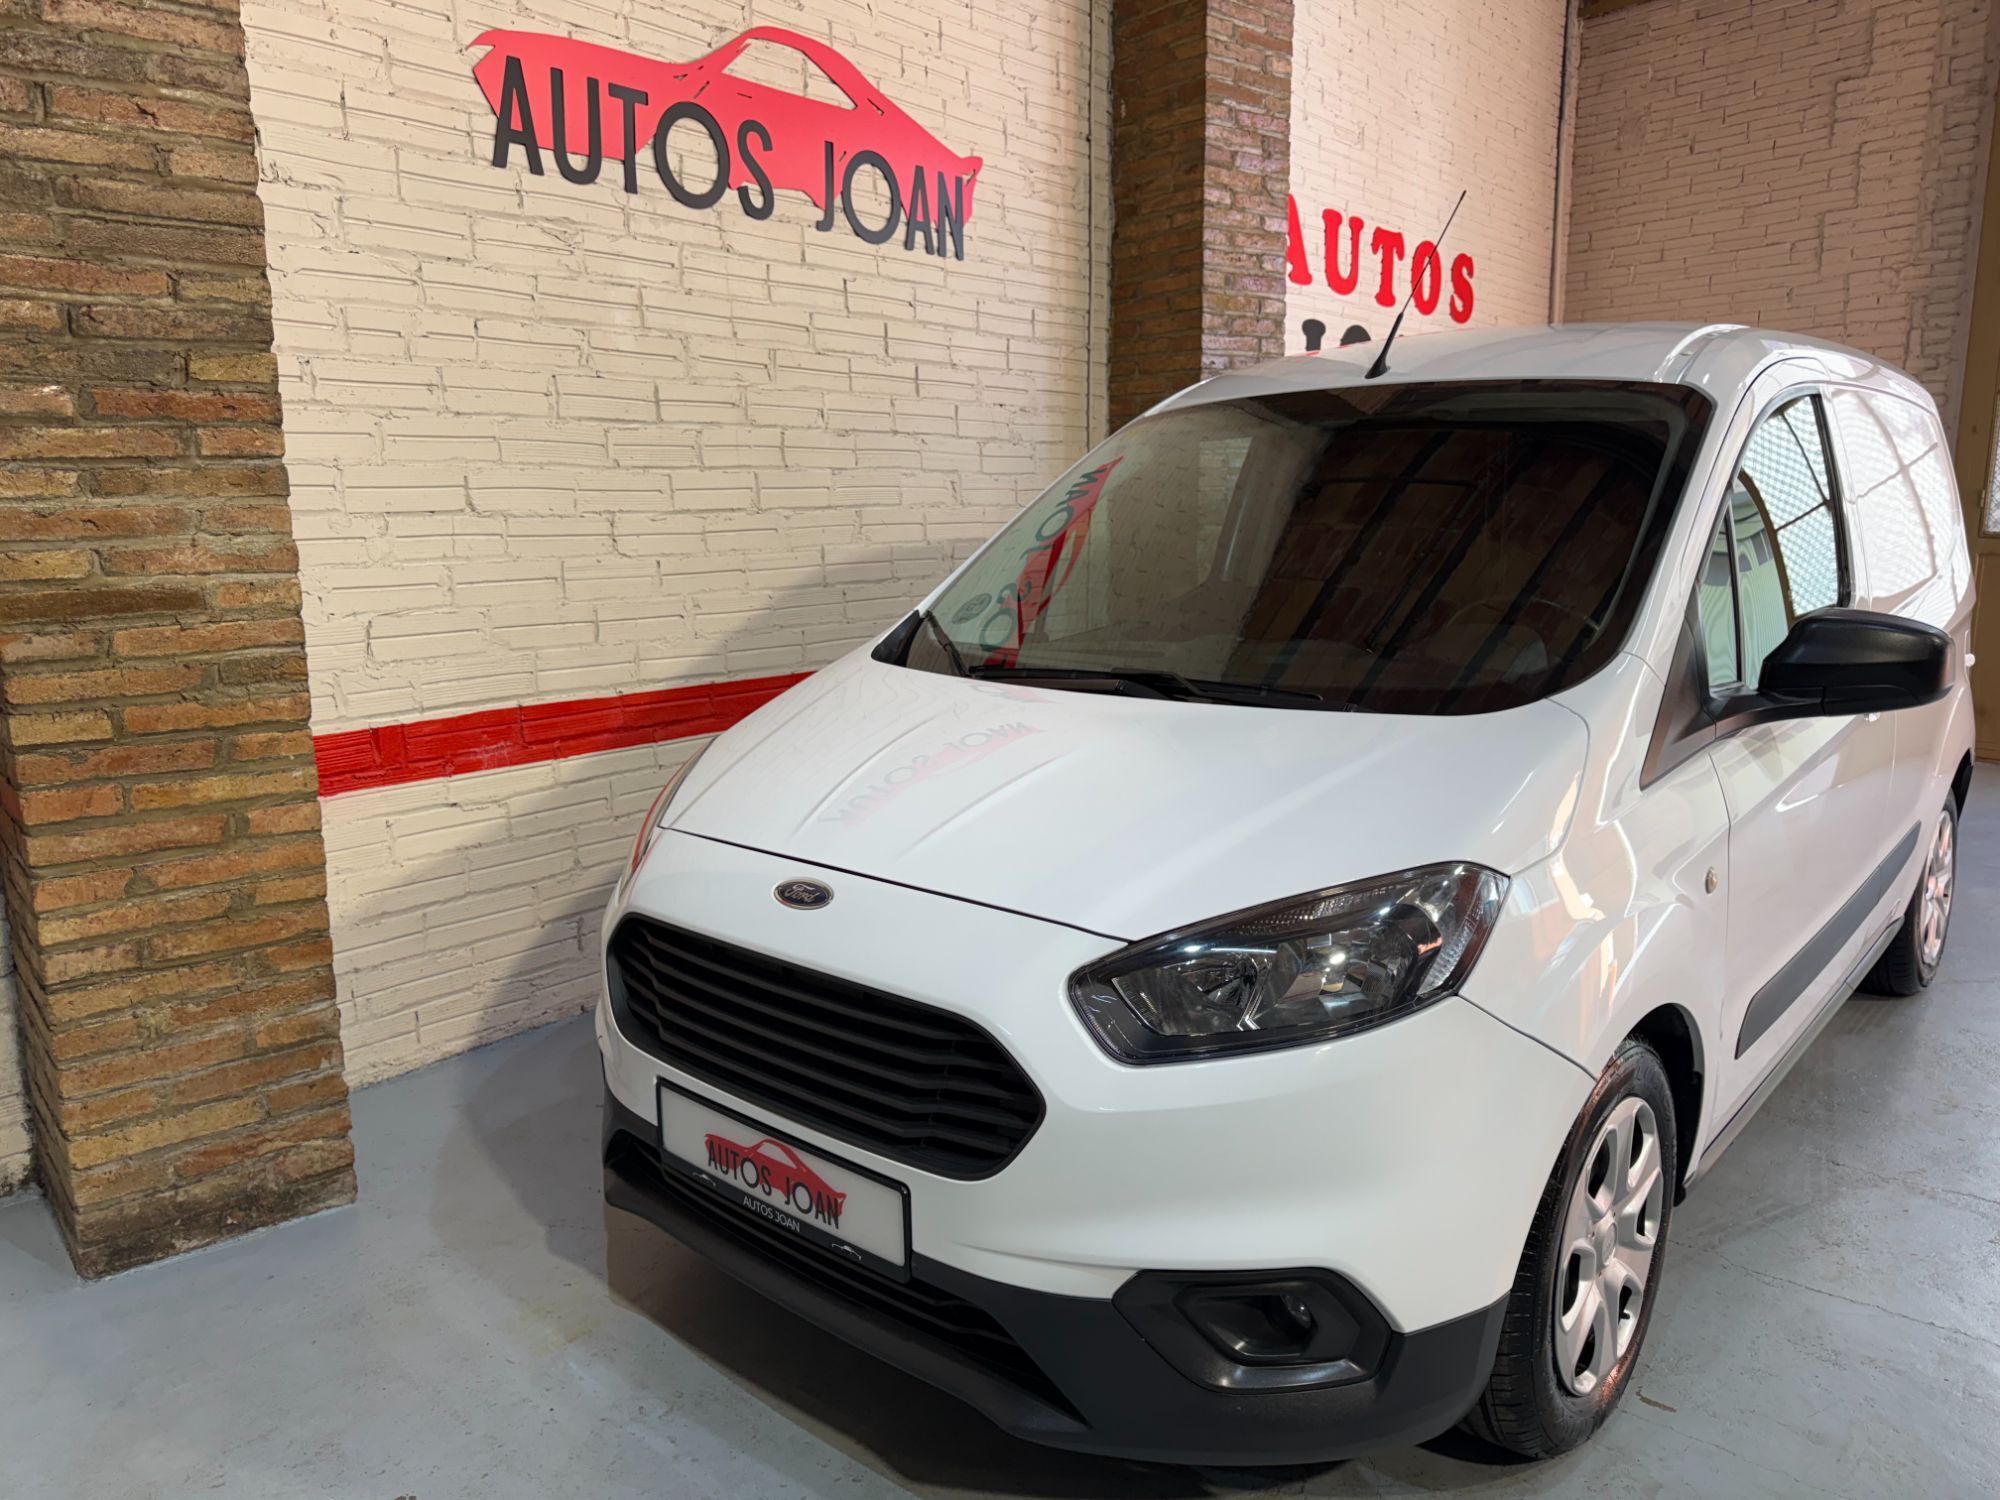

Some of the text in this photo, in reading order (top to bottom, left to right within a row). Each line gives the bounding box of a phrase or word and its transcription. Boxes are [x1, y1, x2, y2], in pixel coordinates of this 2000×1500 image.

[492, 54, 965, 261] AUTOS JOAN
[1286, 192, 1475, 325] AUTOS
[784, 882, 821, 903] Ford
[708, 1139, 840, 1230] AUTOS JOAN
[743, 1195, 800, 1233] AUTOS JOAN
